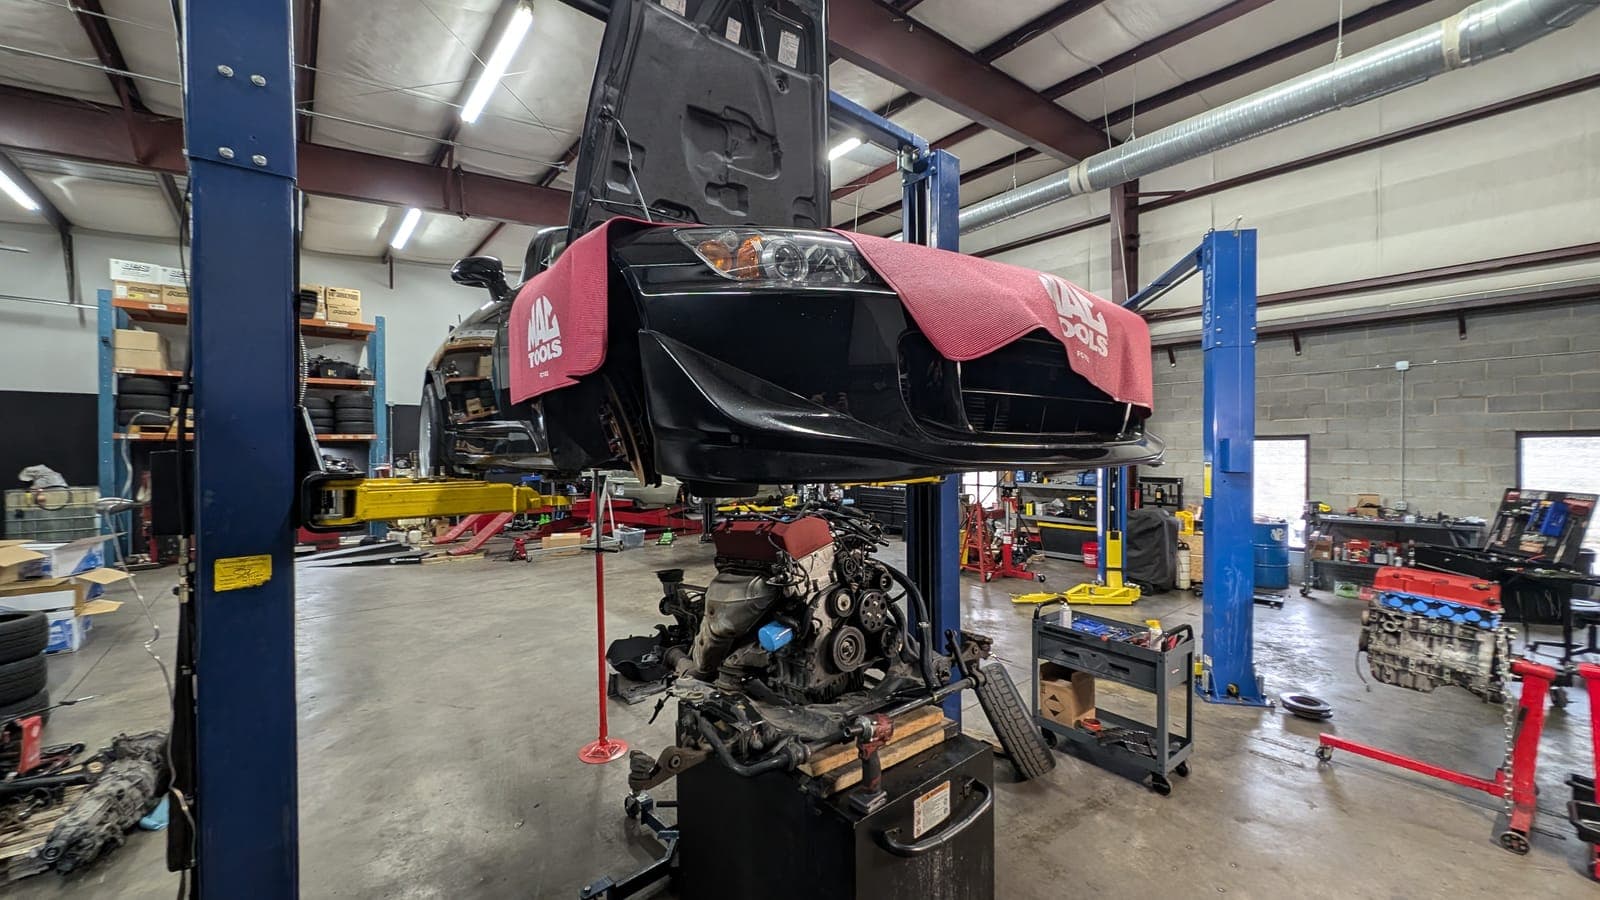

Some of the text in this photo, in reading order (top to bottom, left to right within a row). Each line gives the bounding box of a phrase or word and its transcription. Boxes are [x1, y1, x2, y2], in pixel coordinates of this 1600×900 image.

[1038, 273, 1108, 339] MAC
[1204, 264, 1212, 325] ATLAS
[527, 295, 562, 352] MAC
[1057, 315, 1109, 358] OOLS
[527, 339, 563, 369] TOOLS
